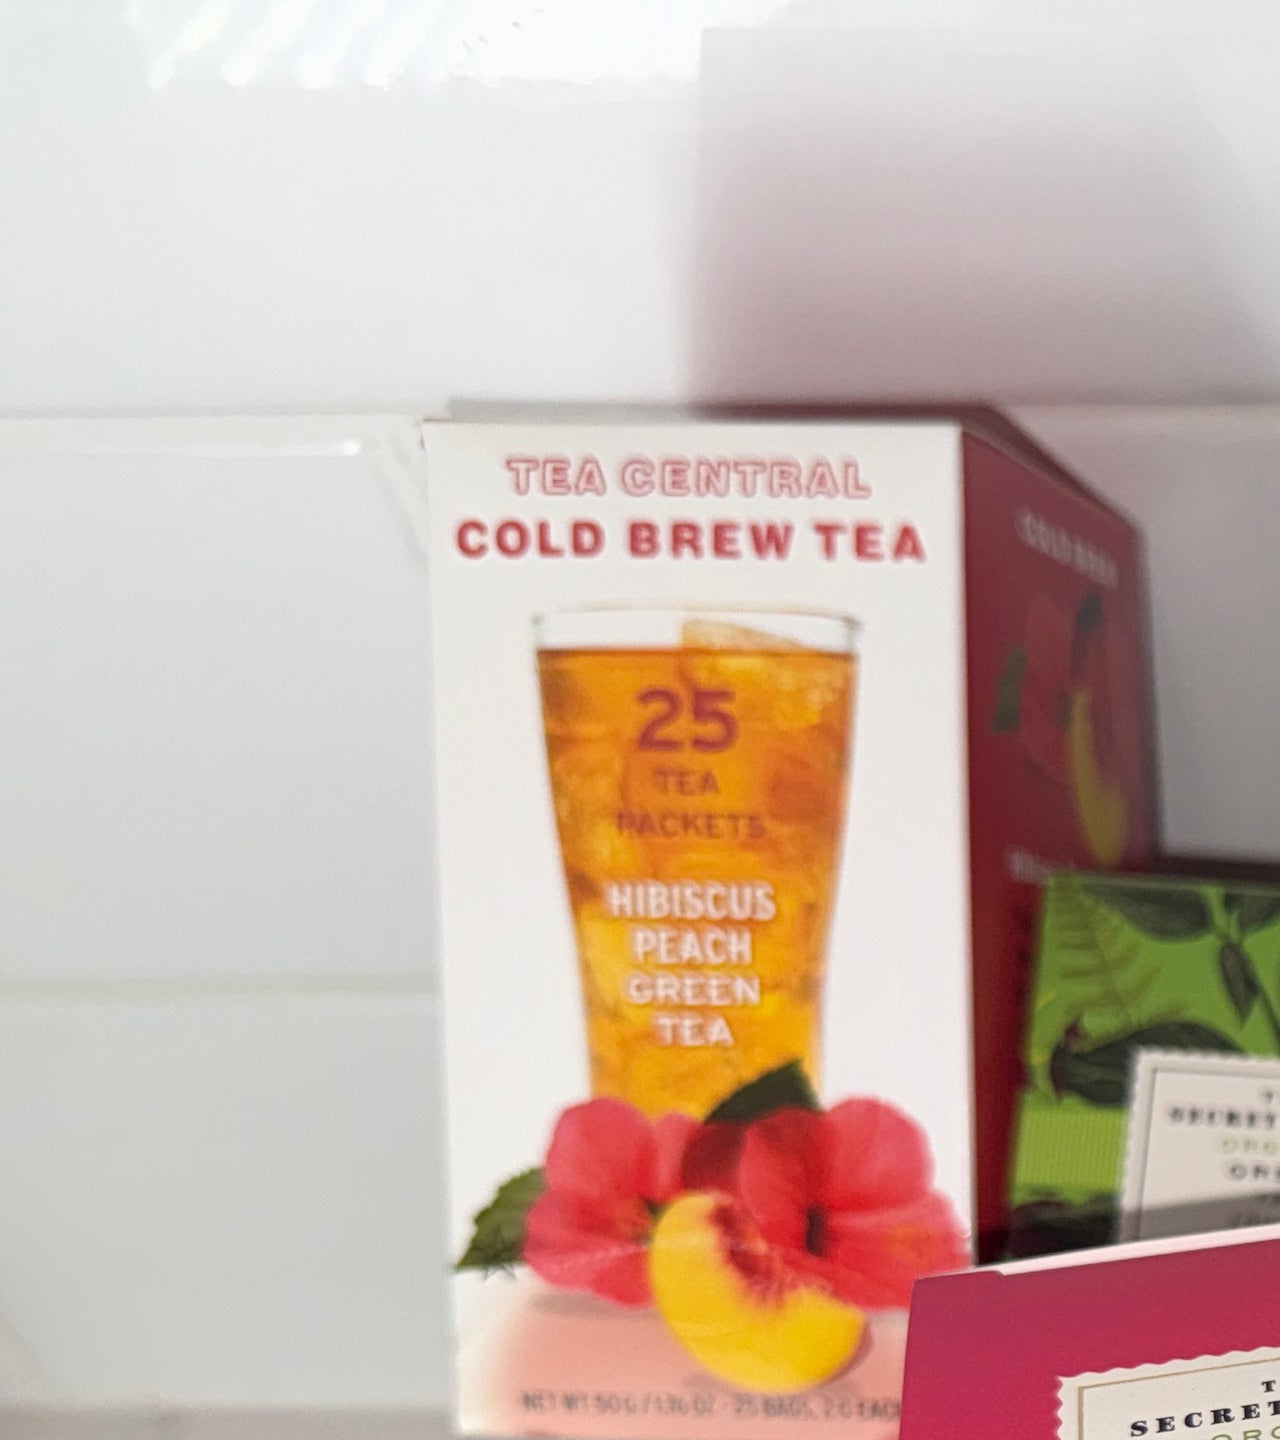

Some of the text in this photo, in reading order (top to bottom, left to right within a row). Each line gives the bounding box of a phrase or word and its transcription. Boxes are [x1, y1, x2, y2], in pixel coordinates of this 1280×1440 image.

[506, 457, 870, 498] TEA CENTRAL
[456, 521, 927, 563] COLD BREW TEA
[636, 689, 739, 753] 25
[653, 768, 720, 796] TEA
[614, 811, 766, 840] PACKETS
[604, 883, 777, 922] HIBISCUS
[631, 928, 752, 965] PEACH
[626, 976, 761, 1007] GREEN
[655, 1016, 733, 1048] TEA
